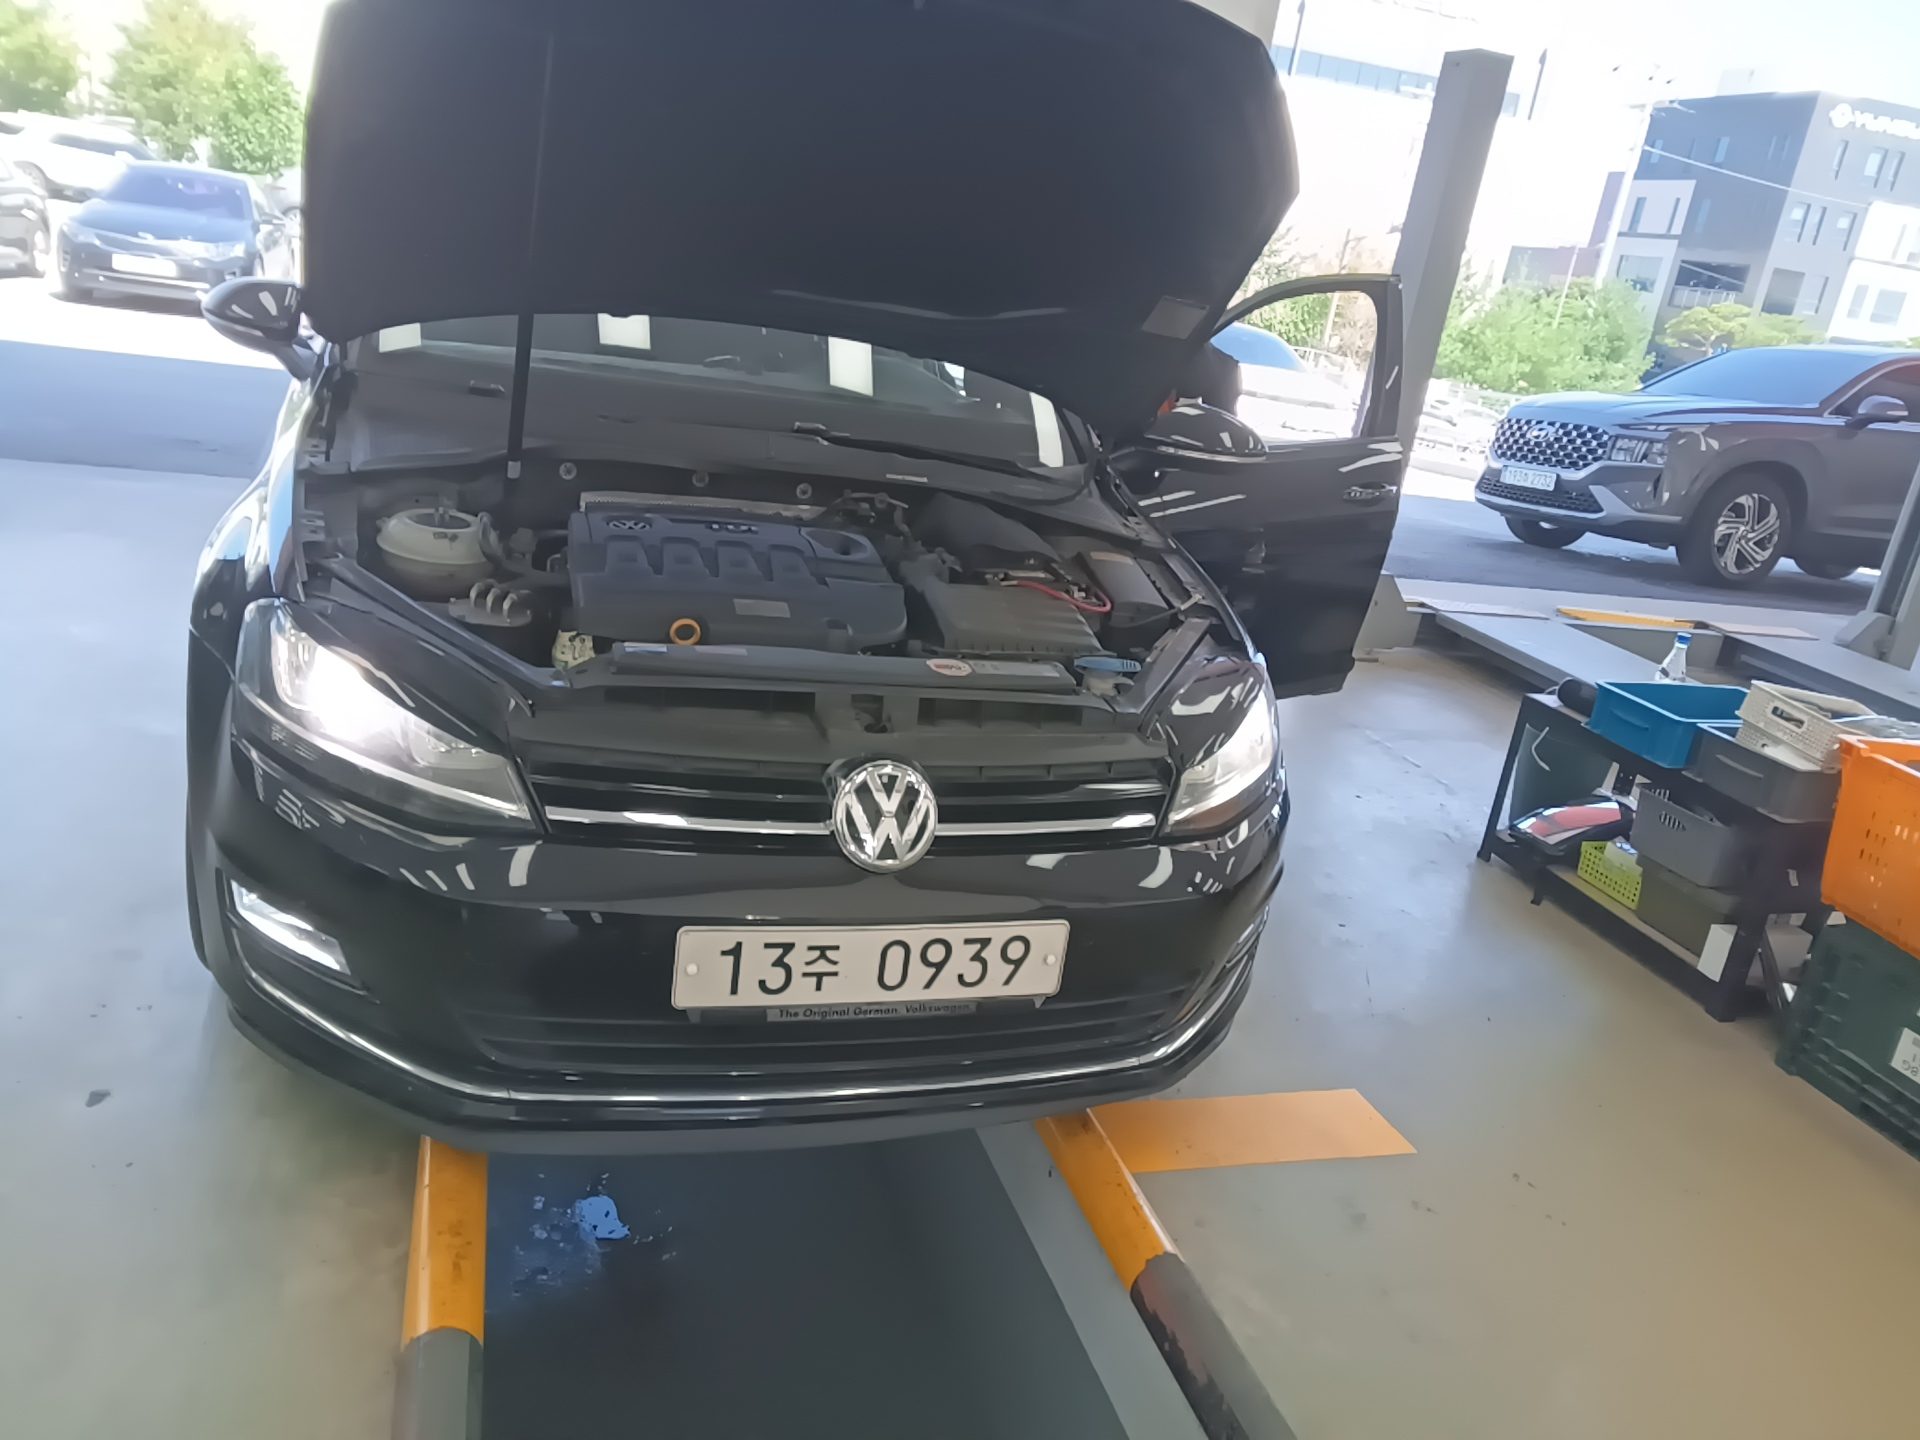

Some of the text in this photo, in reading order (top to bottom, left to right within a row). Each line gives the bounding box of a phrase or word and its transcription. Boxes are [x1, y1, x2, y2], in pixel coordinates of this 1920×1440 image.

[720, 934, 1032, 997] 13주 0939
[778, 1009, 799, 1018] The
[803, 1007, 850, 1020] Original
